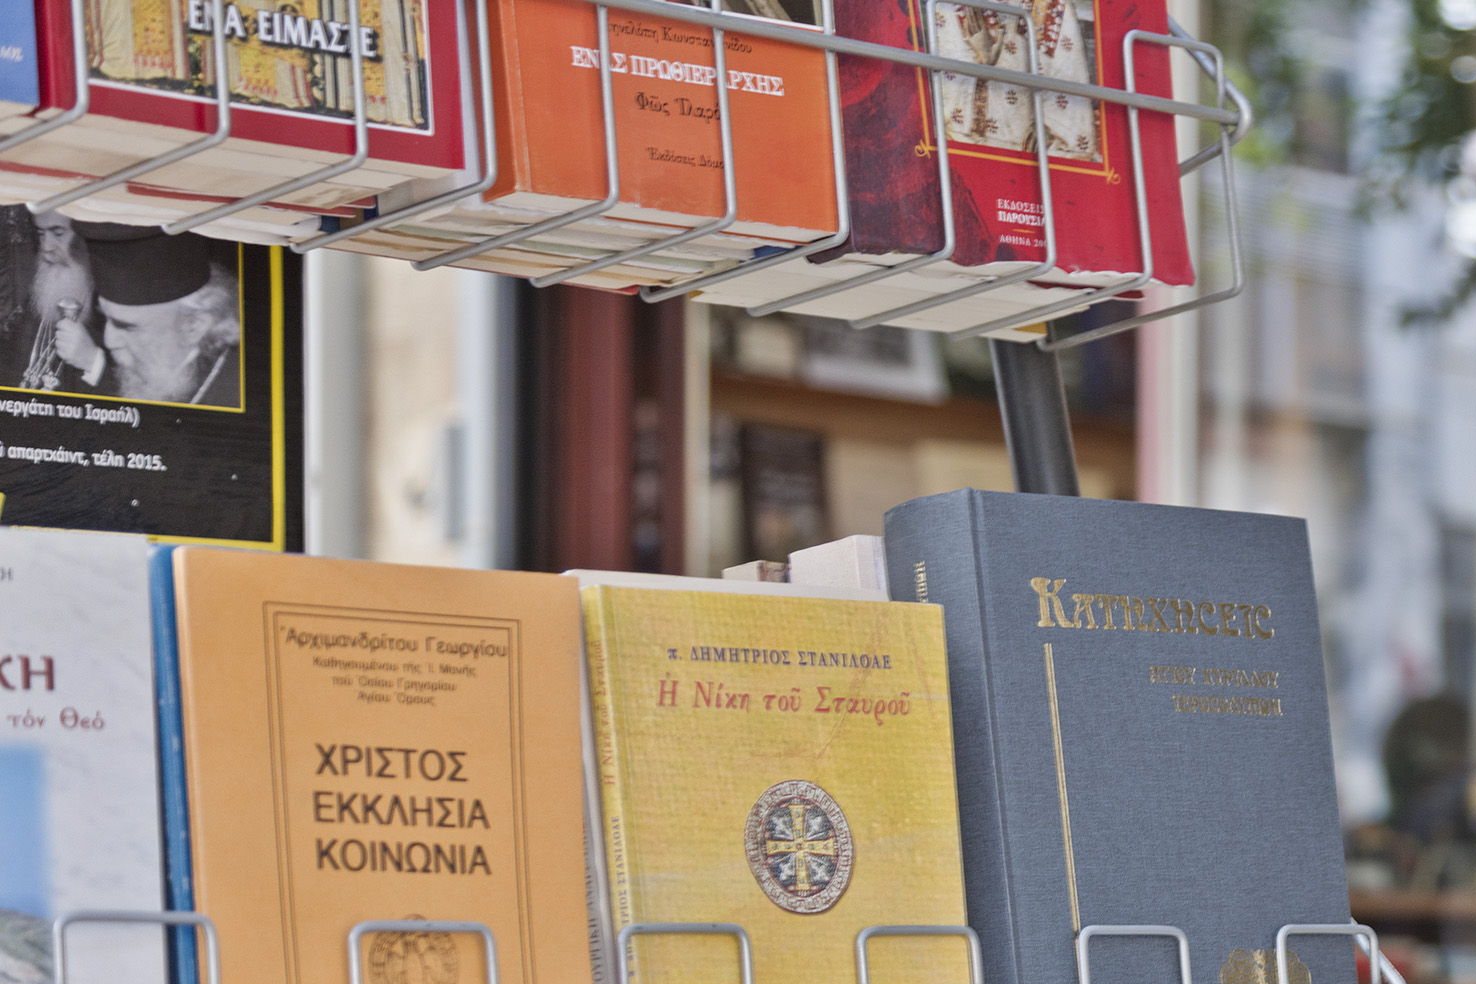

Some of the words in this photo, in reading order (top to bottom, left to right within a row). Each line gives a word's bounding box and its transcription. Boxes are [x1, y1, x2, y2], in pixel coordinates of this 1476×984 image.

[257, 10, 377, 58] ΕΙΜΑΣΕ
[570, 45, 628, 73] ΕΝΣ
[630, 54, 785, 97] ΠΡΩΘΙΕΡΡΧΗΣ
[56, 405, 84, 420] του
[85, 403, 141, 429] Ισραήλ)
[91, 449, 125, 468] τέλη
[127, 453, 168, 472] 2015.
[425, 635, 509, 659] Γεωργίου
[689, 645, 792, 667] ΔΗΜΗΤΡΙΟΣ
[797, 650, 894, 671] ΣΤΑΝΙΛΟΑΕ
[315, 742, 469, 783] ΧΡΙΣΤΟΣ
[313, 790, 491, 830] ΕΚΚΛΗΣΙΑ
[315, 837, 492, 877] ΚΟΙΝΩΝΙΑ
